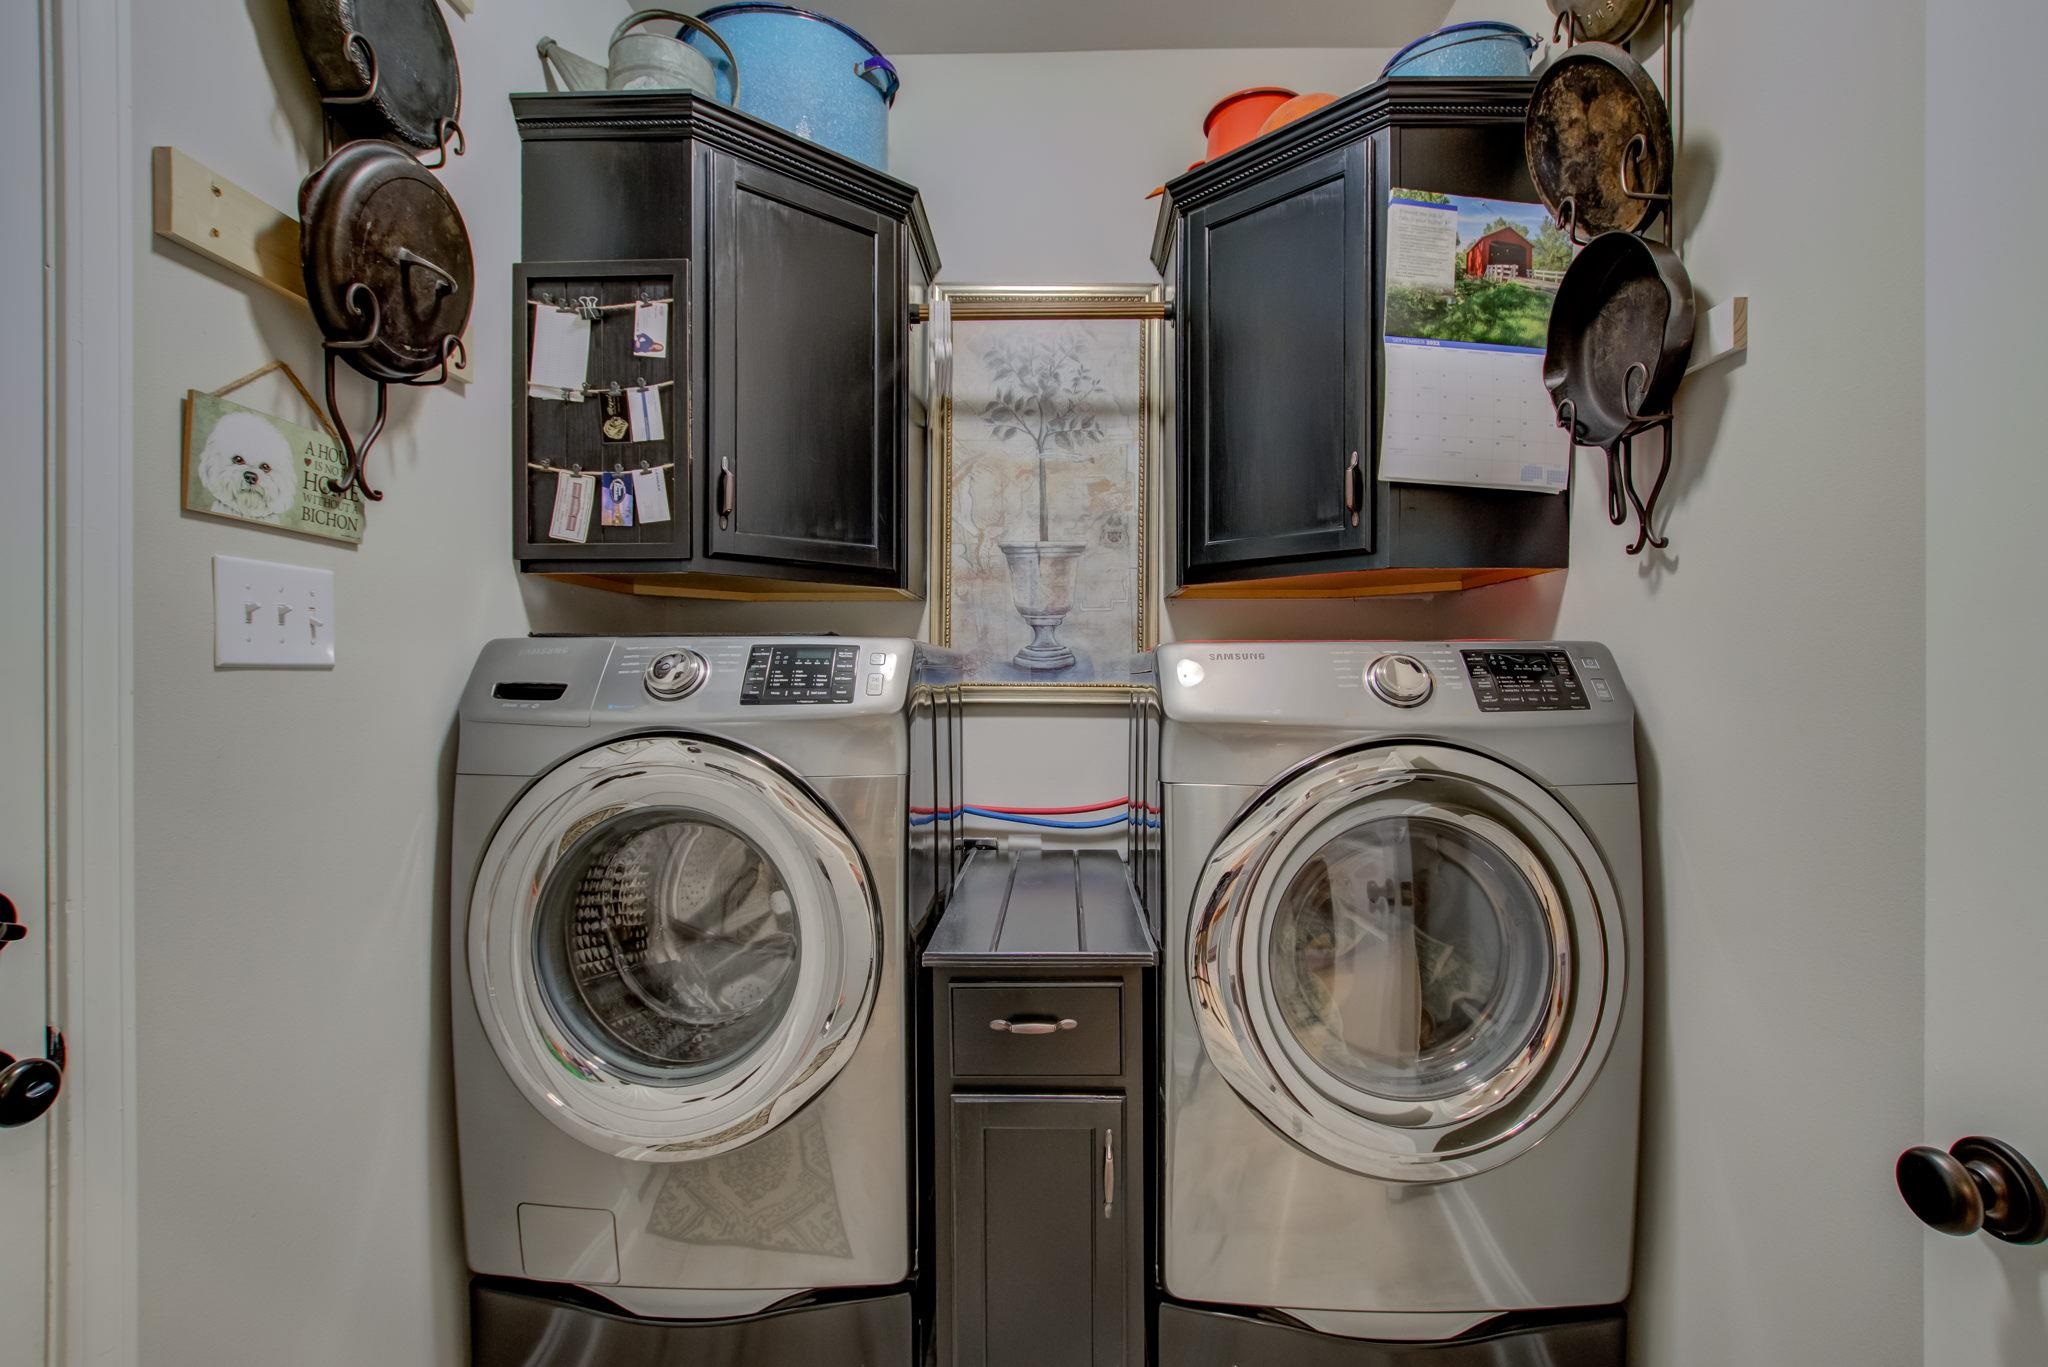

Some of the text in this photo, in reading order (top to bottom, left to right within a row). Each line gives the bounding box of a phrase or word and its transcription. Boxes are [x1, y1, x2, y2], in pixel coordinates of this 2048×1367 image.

[305, 441, 347, 466] A HOU
[315, 461, 323, 472] IS
[303, 470, 360, 503] HOE
[303, 493, 351, 513] WITHOUT
[302, 506, 359, 532] BICHON
[1208, 652, 1266, 661] SAMSUNG
